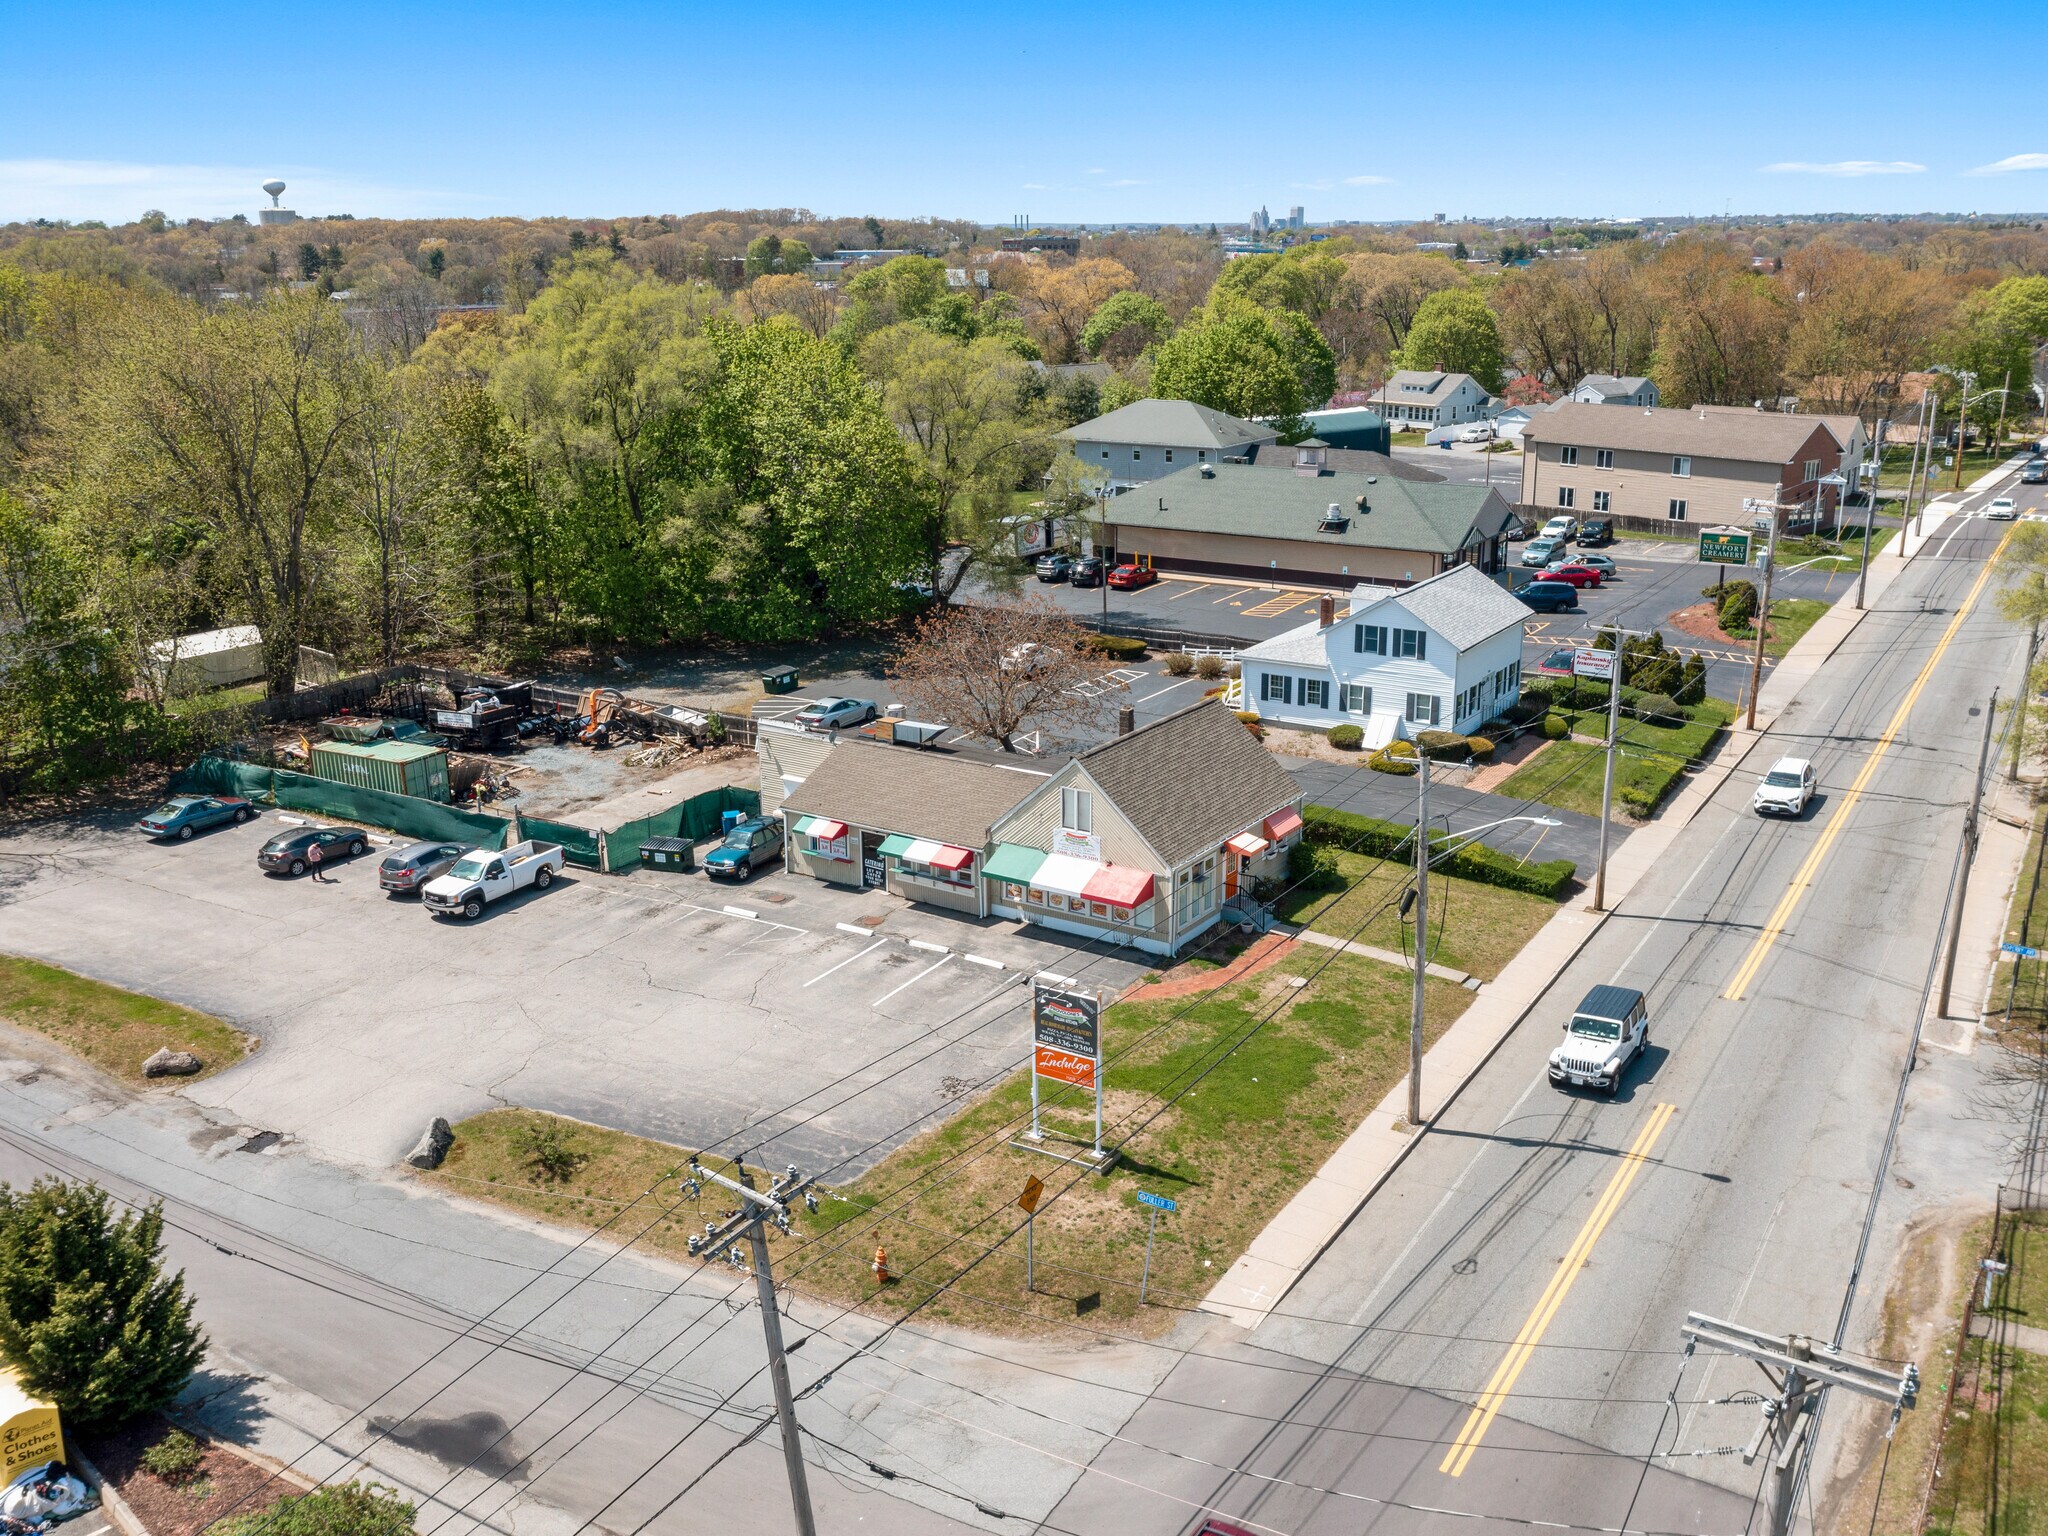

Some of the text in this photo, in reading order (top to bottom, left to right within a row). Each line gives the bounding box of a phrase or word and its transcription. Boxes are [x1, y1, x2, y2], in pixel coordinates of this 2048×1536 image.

[1702, 543, 1745, 553] NEWPORT
[1702, 549, 1744, 559] CREAMERY
[1576, 660, 1610, 668] Insurance
[1039, 1034, 1094, 1054] 508-336-9300
[1039, 1051, 1092, 1075] Indulge
[1145, 1195, 1174, 1209] FULLER ST
[4, 1431, 56, 1454] Clothes
[6, 1456, 16, 1466] &
[18, 1442, 58, 1462] Shoes
